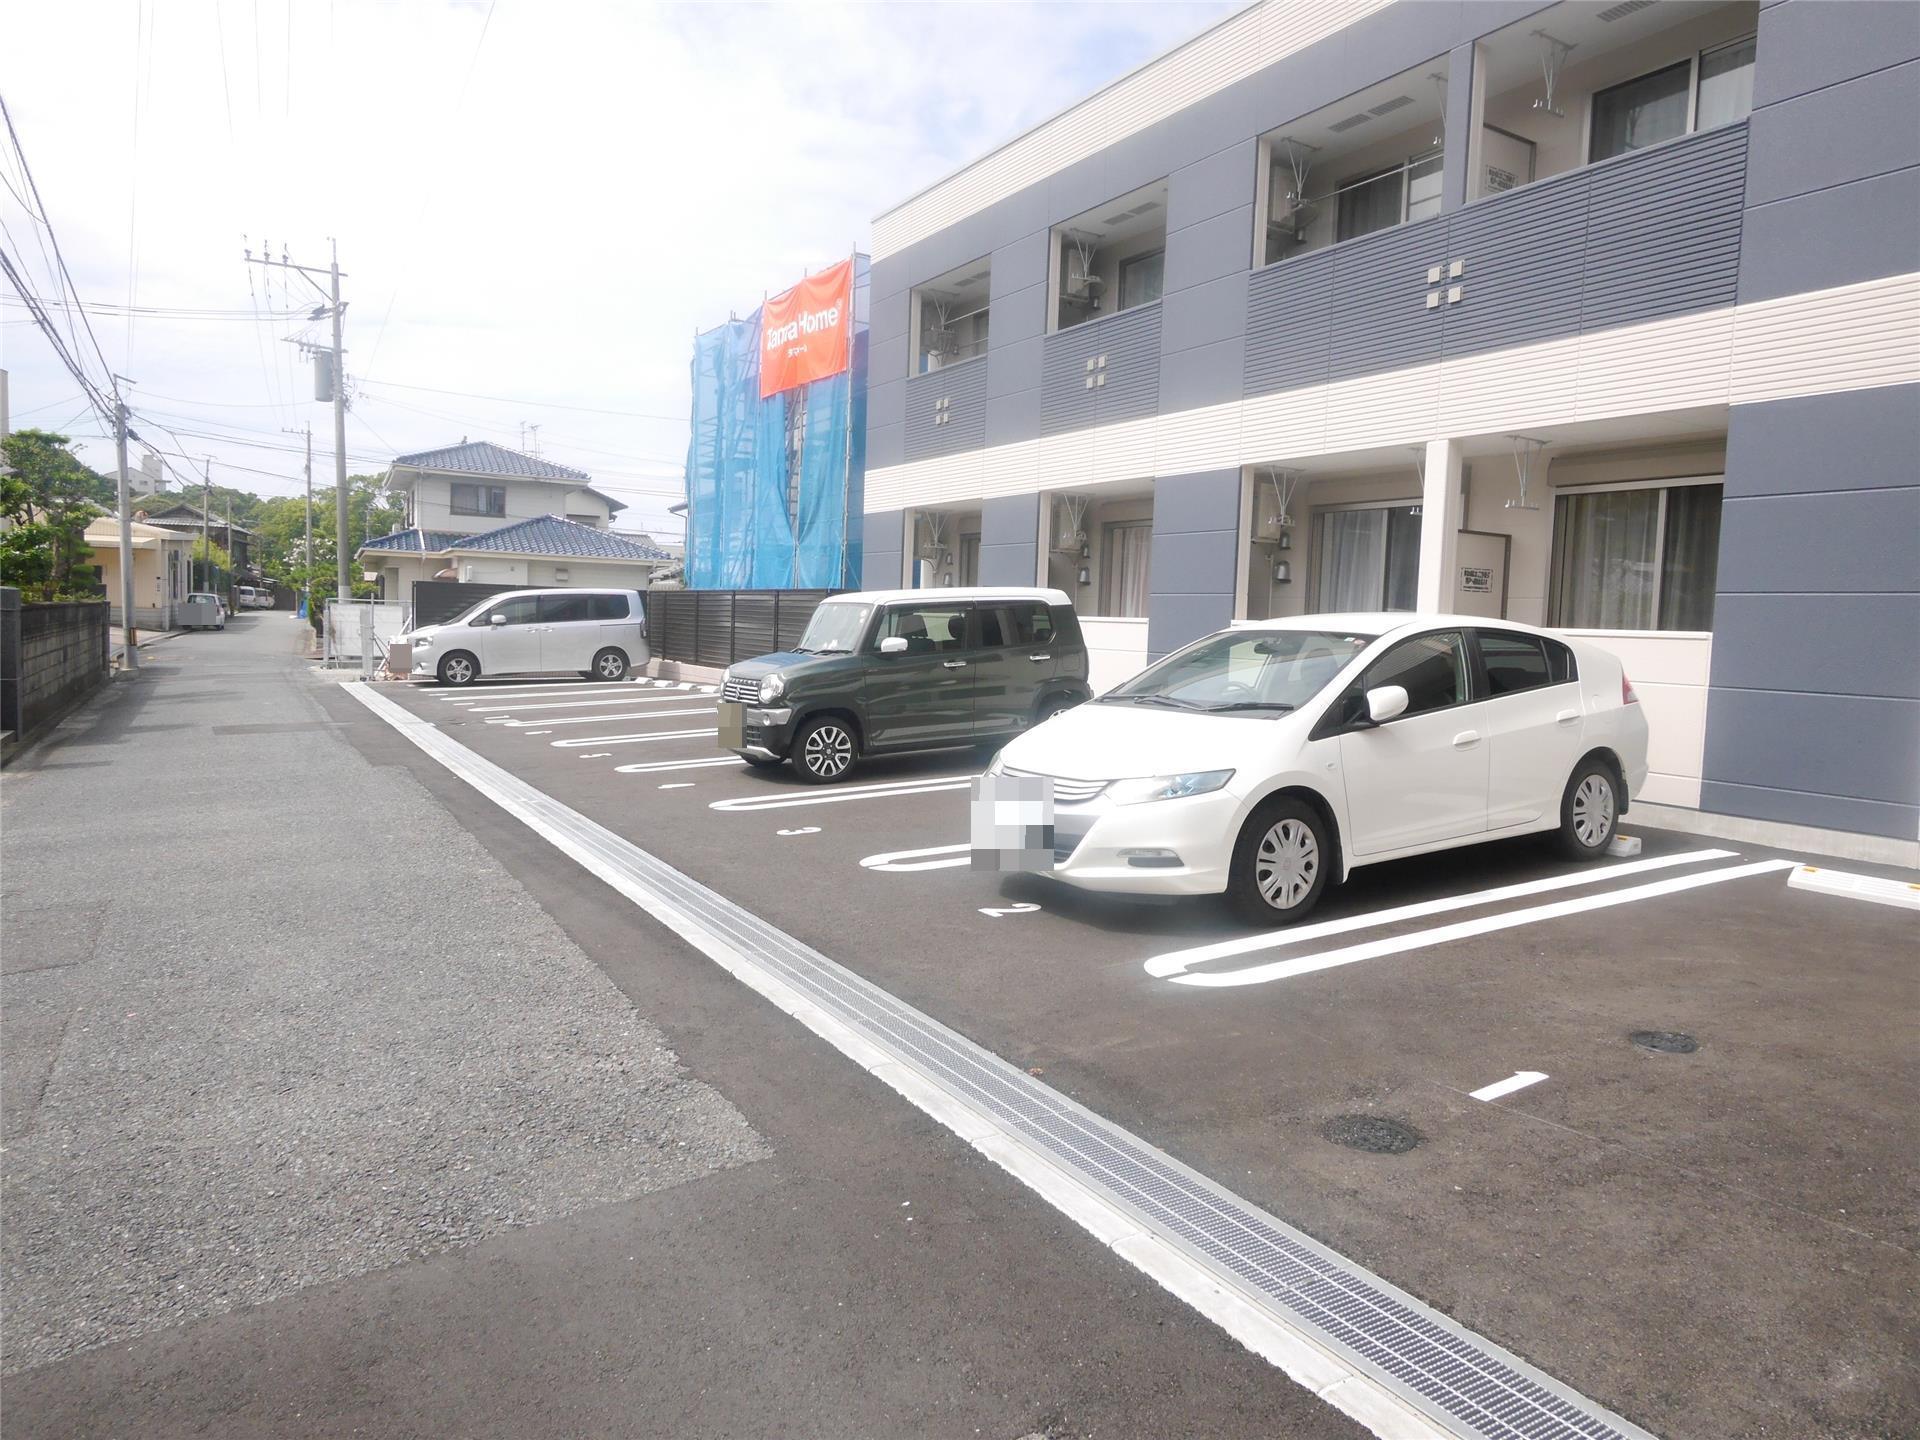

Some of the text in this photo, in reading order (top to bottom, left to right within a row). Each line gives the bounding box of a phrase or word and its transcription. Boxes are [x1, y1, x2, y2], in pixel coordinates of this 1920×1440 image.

[798, 307, 838, 334] Home
[776, 826, 822, 836] 3
[977, 902, 1042, 917] 2
[1468, 1071, 1550, 1101] 1
